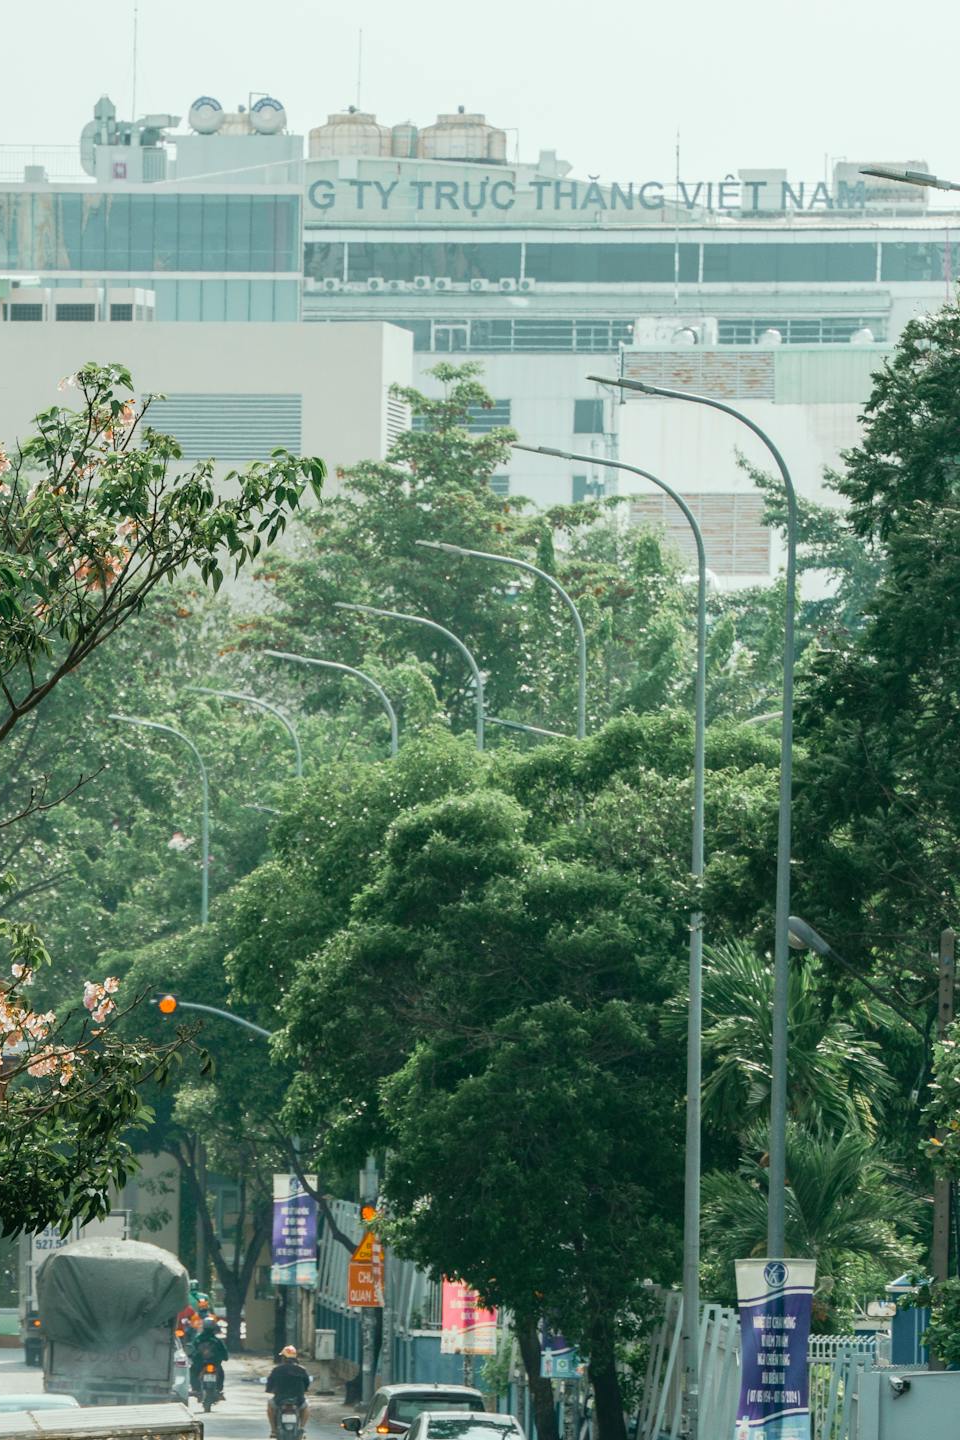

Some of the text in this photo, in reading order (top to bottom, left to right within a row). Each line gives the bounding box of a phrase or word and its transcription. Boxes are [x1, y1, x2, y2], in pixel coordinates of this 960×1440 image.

[308, 173, 866, 217] G TY TRỰC THĂNG VIỆT NAM
